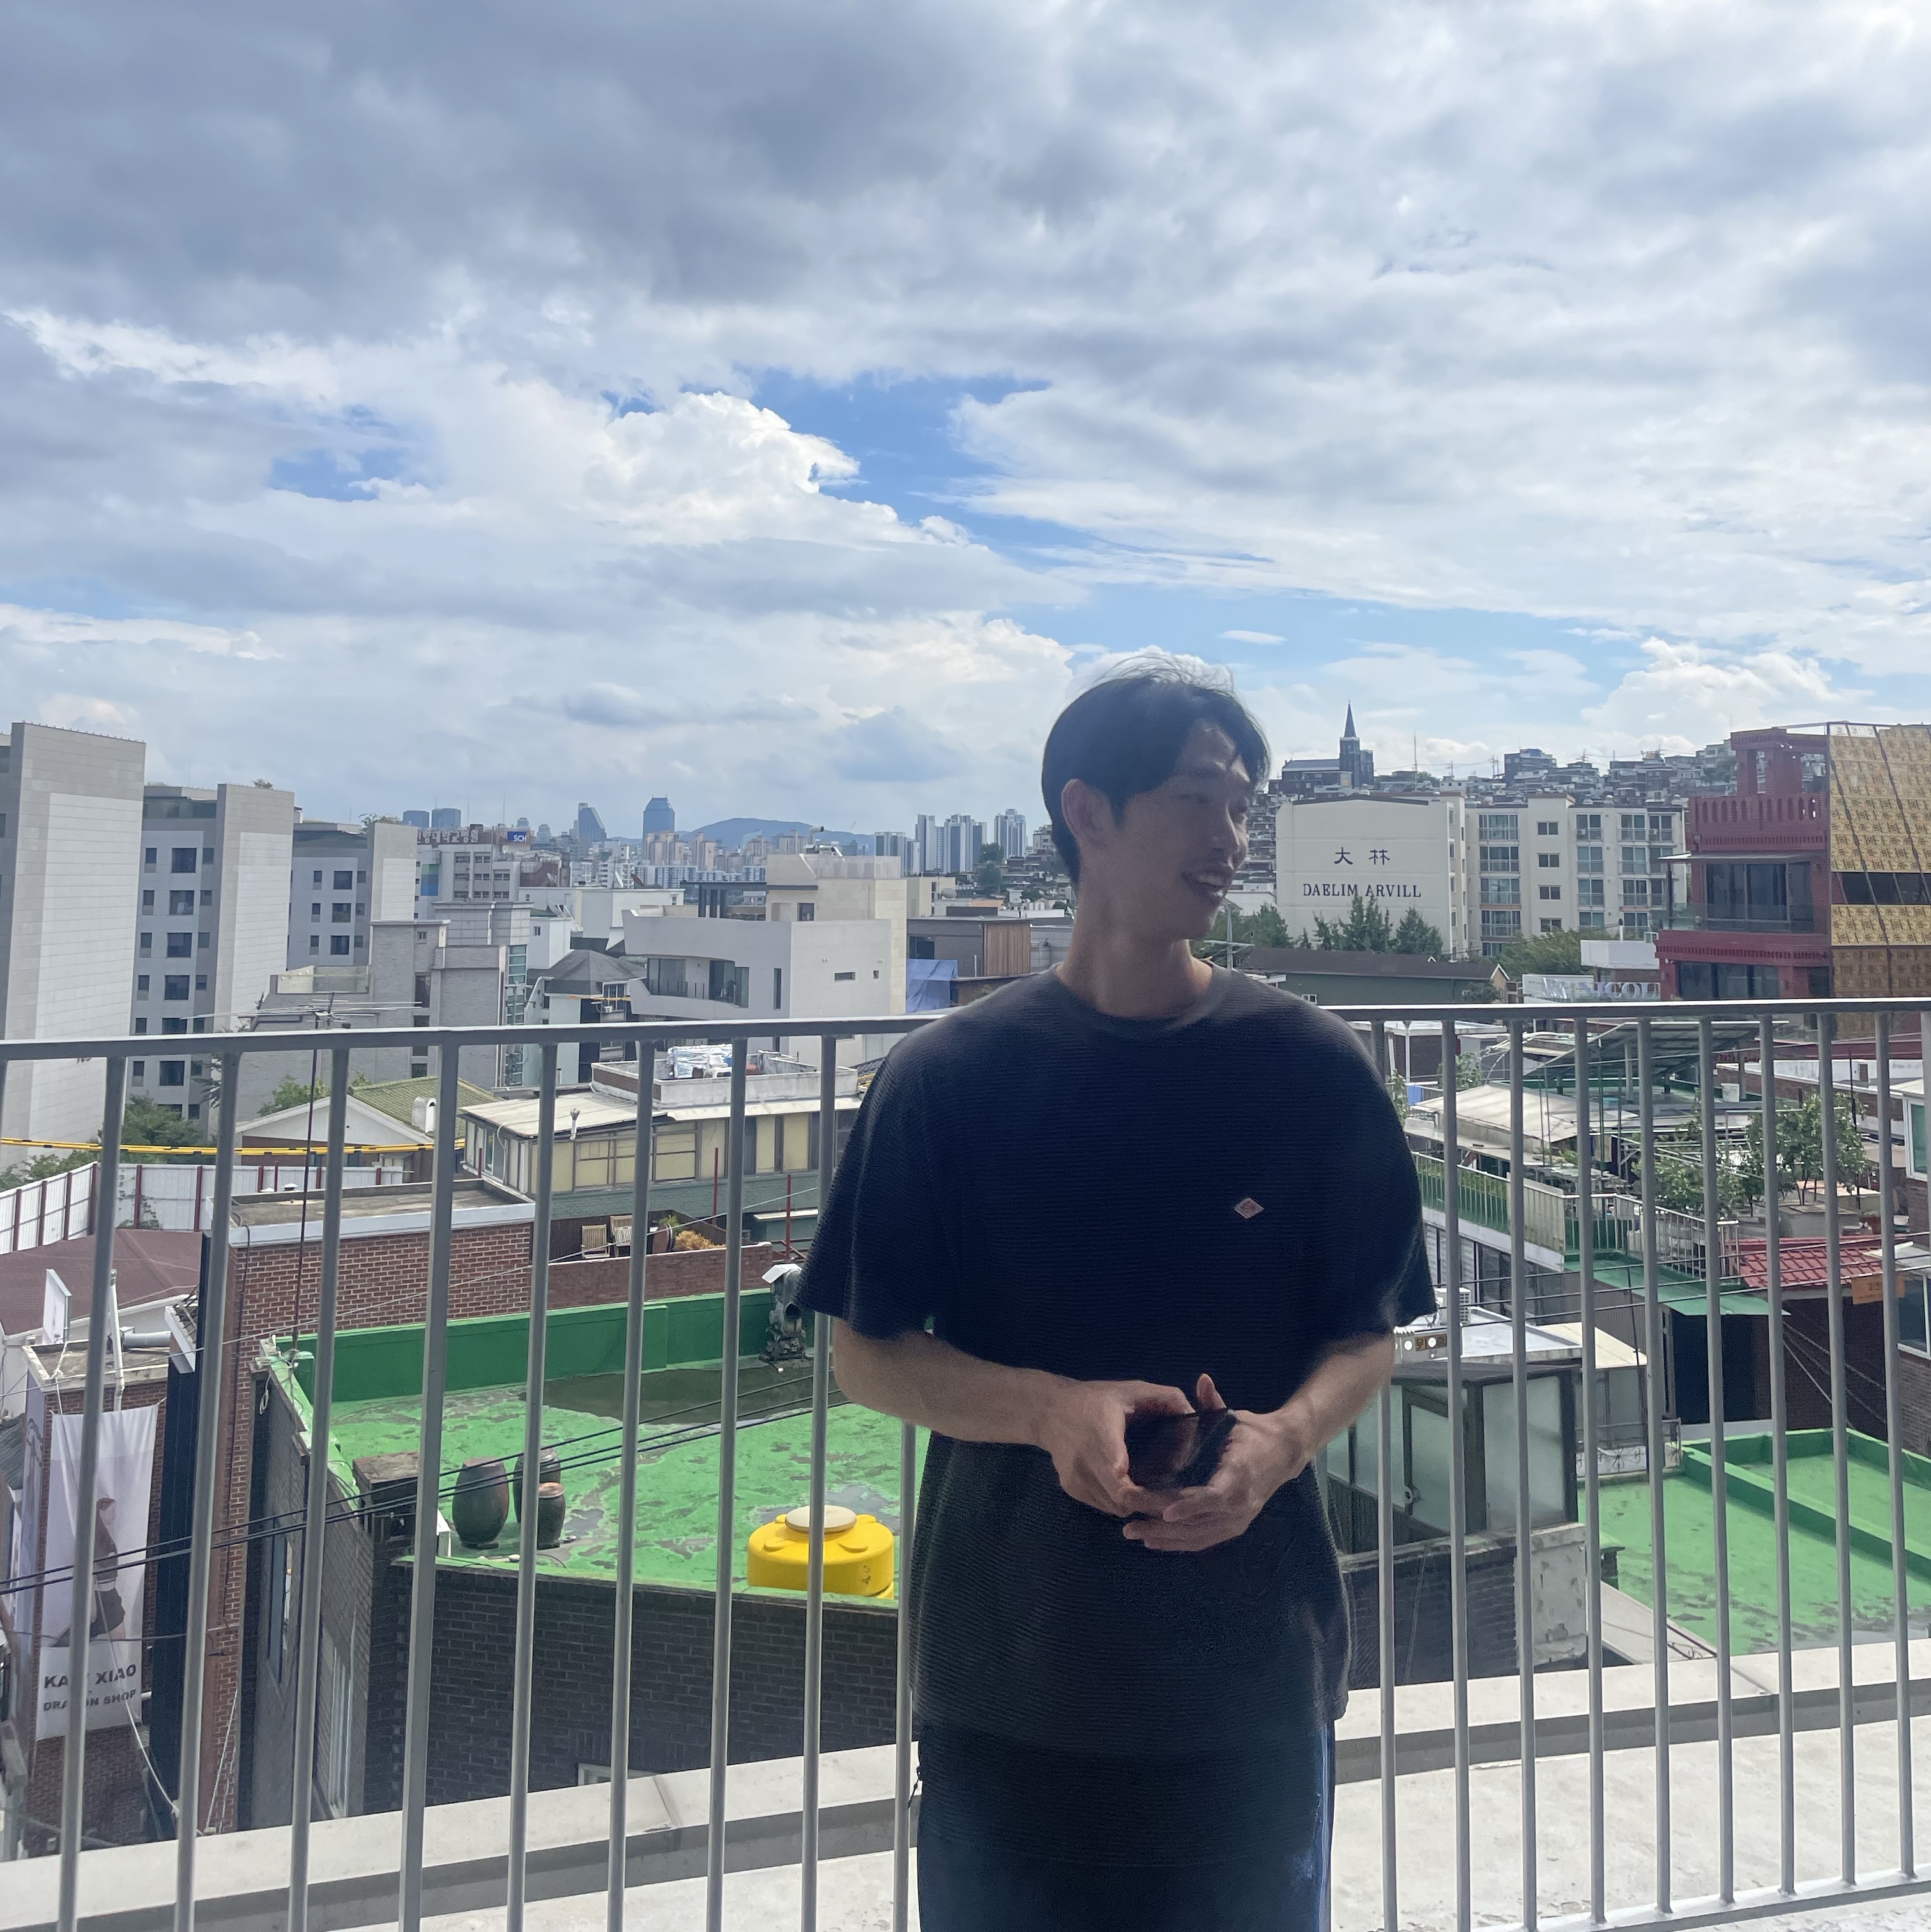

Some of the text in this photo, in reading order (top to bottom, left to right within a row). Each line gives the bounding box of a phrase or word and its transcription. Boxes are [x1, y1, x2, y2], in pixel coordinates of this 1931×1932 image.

[1334, 847, 1391, 865] 大林
[1303, 884, 1421, 898] DAELIM ARVILL
[95, 1664, 137, 1685] XIAO
[103, 1689, 136, 1704] SHOP
